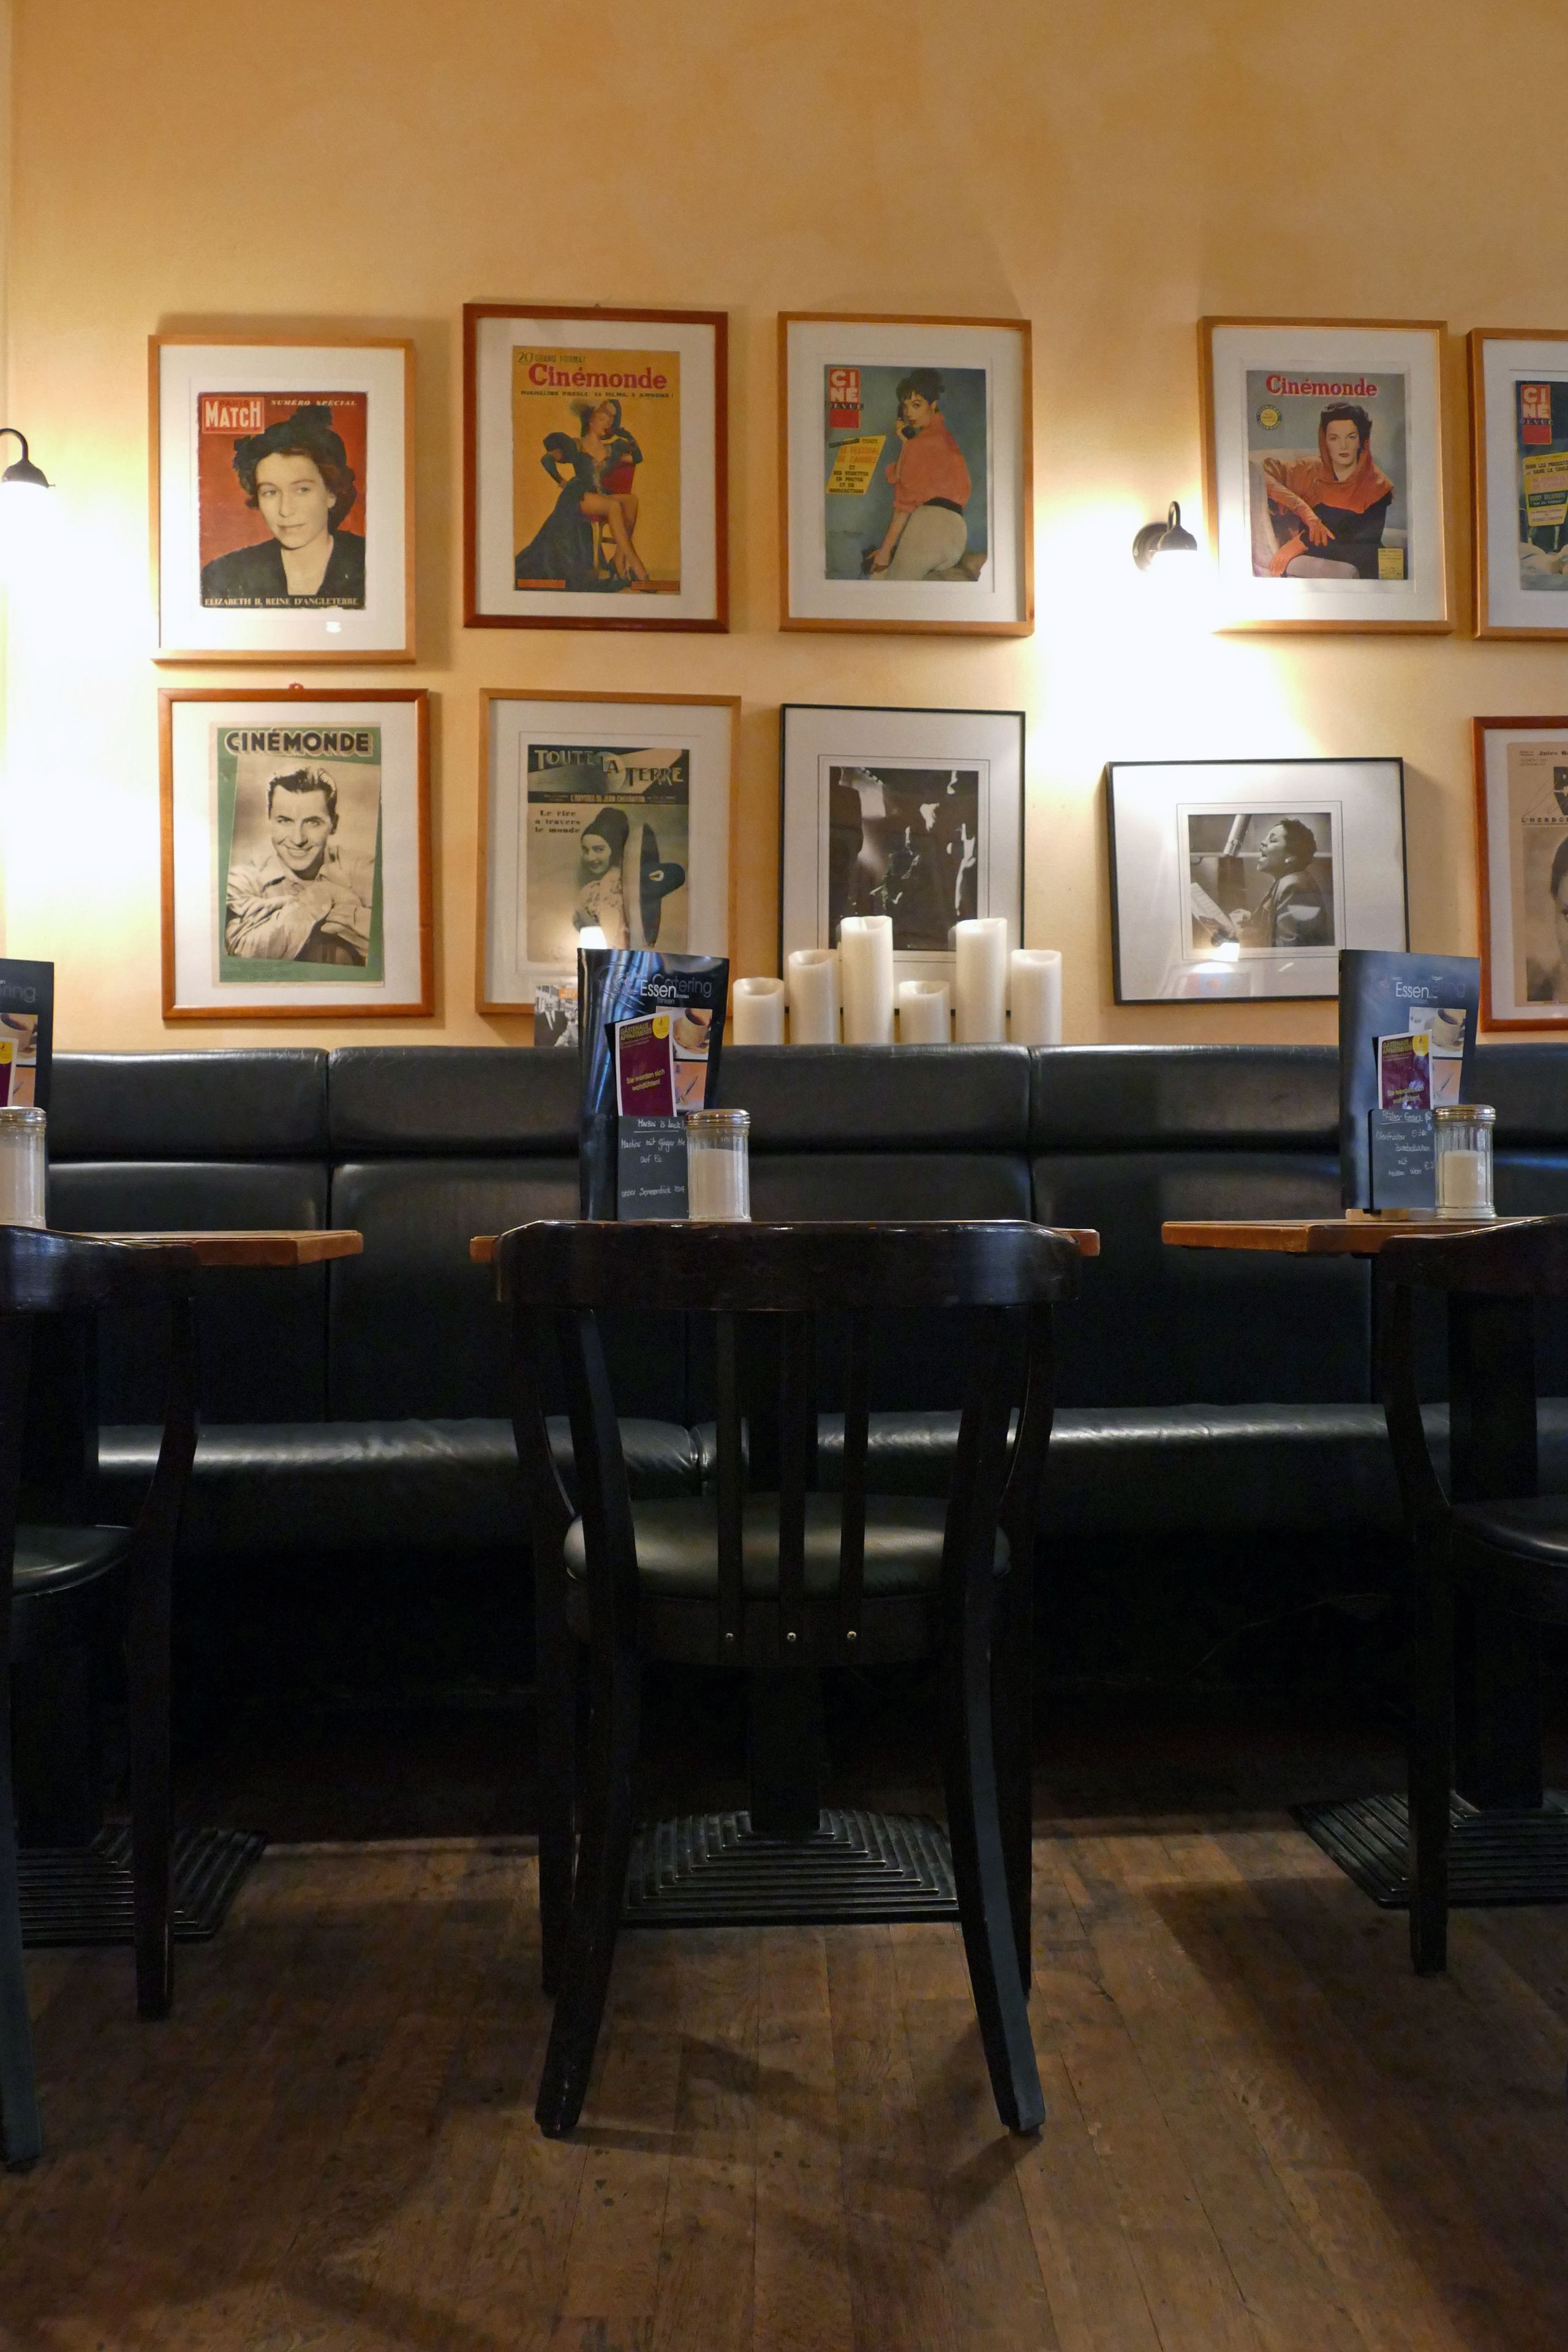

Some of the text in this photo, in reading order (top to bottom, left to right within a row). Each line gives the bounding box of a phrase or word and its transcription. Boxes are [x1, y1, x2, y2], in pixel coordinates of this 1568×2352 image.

[529, 363, 667, 390] Cinémonde
[831, 370, 856, 386] CI
[1265, 373, 1378, 397] Cinémonde
[1524, 387, 1547, 403] CI
[205, 400, 262, 428] MATCH
[225, 728, 372, 756] CINÉMONDE
[534, 749, 594, 770] TOUTE
[626, 766, 684, 786] TERRE
[640, 979, 677, 998] Essen
[1395, 982, 1430, 998] Essen
[638, 1118, 656, 1128] Martini
[660, 1120, 666, 1128] is
[621, 1138, 641, 1148] Martini
[646, 1137, 656, 1146] mit
[658, 1138, 675, 1153] Ginger
